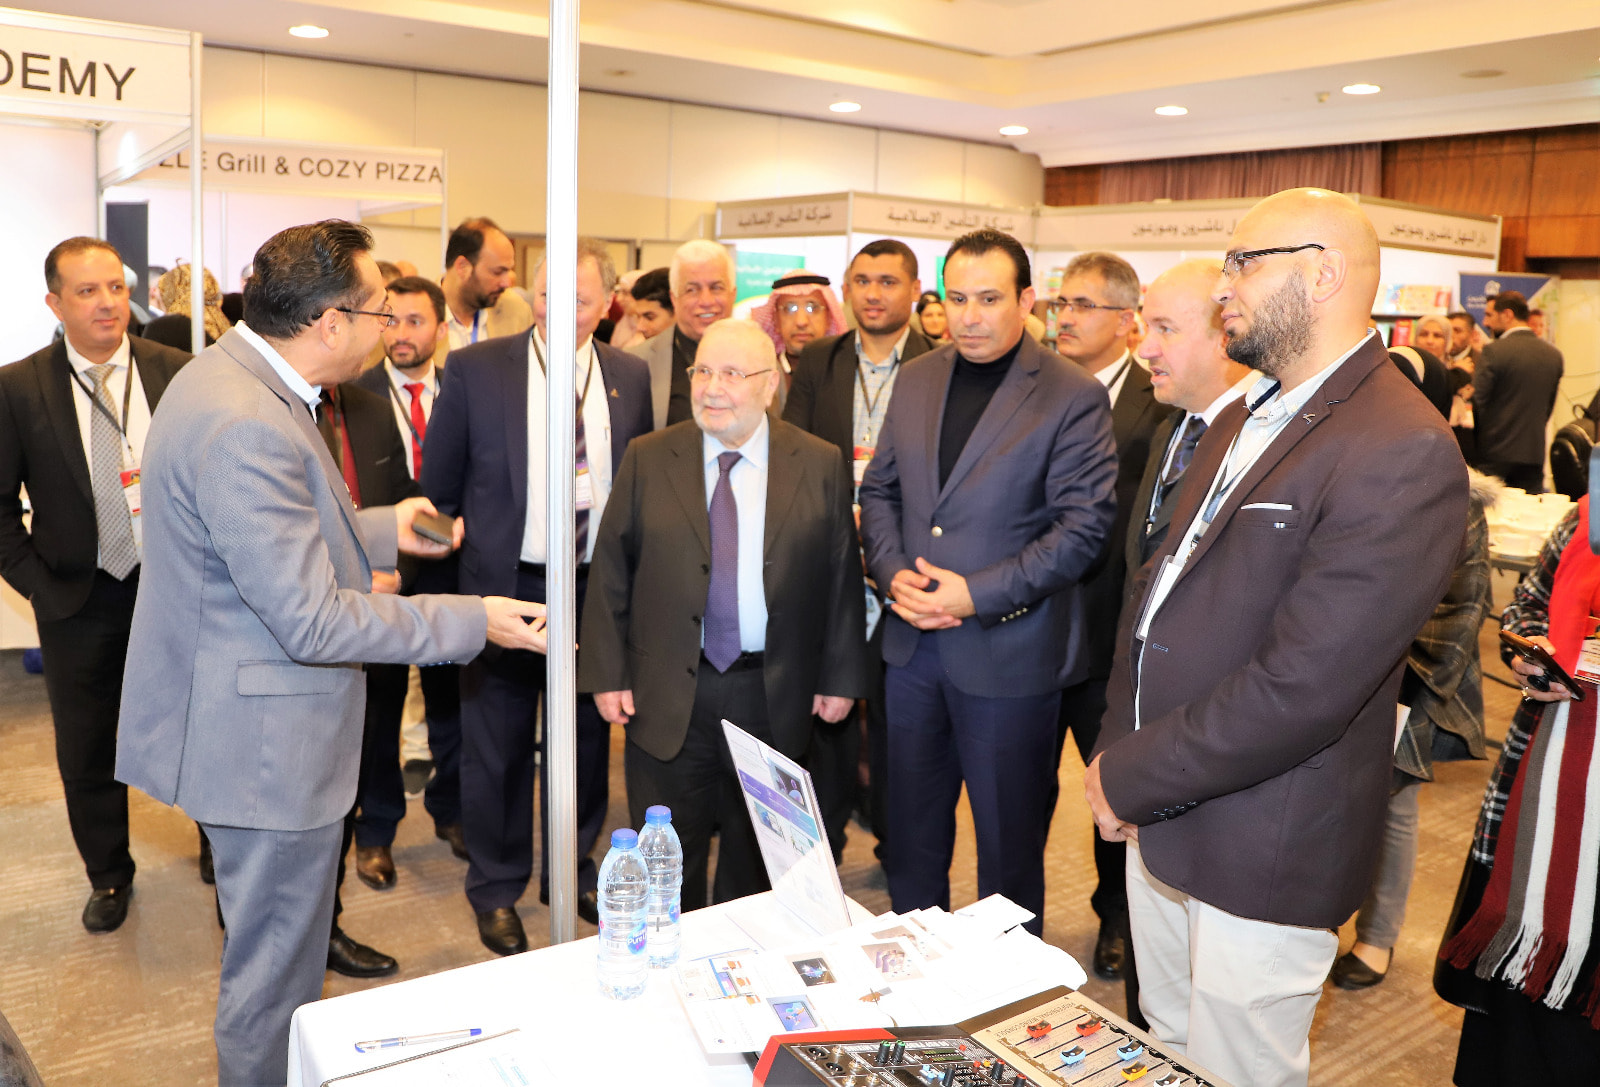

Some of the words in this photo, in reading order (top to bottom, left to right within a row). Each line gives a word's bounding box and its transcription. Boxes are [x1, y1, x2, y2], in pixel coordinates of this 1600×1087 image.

[217, 152, 265, 174] Grill
[275, 156, 290, 175] &
[299, 157, 367, 178] COZY
[376, 162, 443, 183] PIZZA
